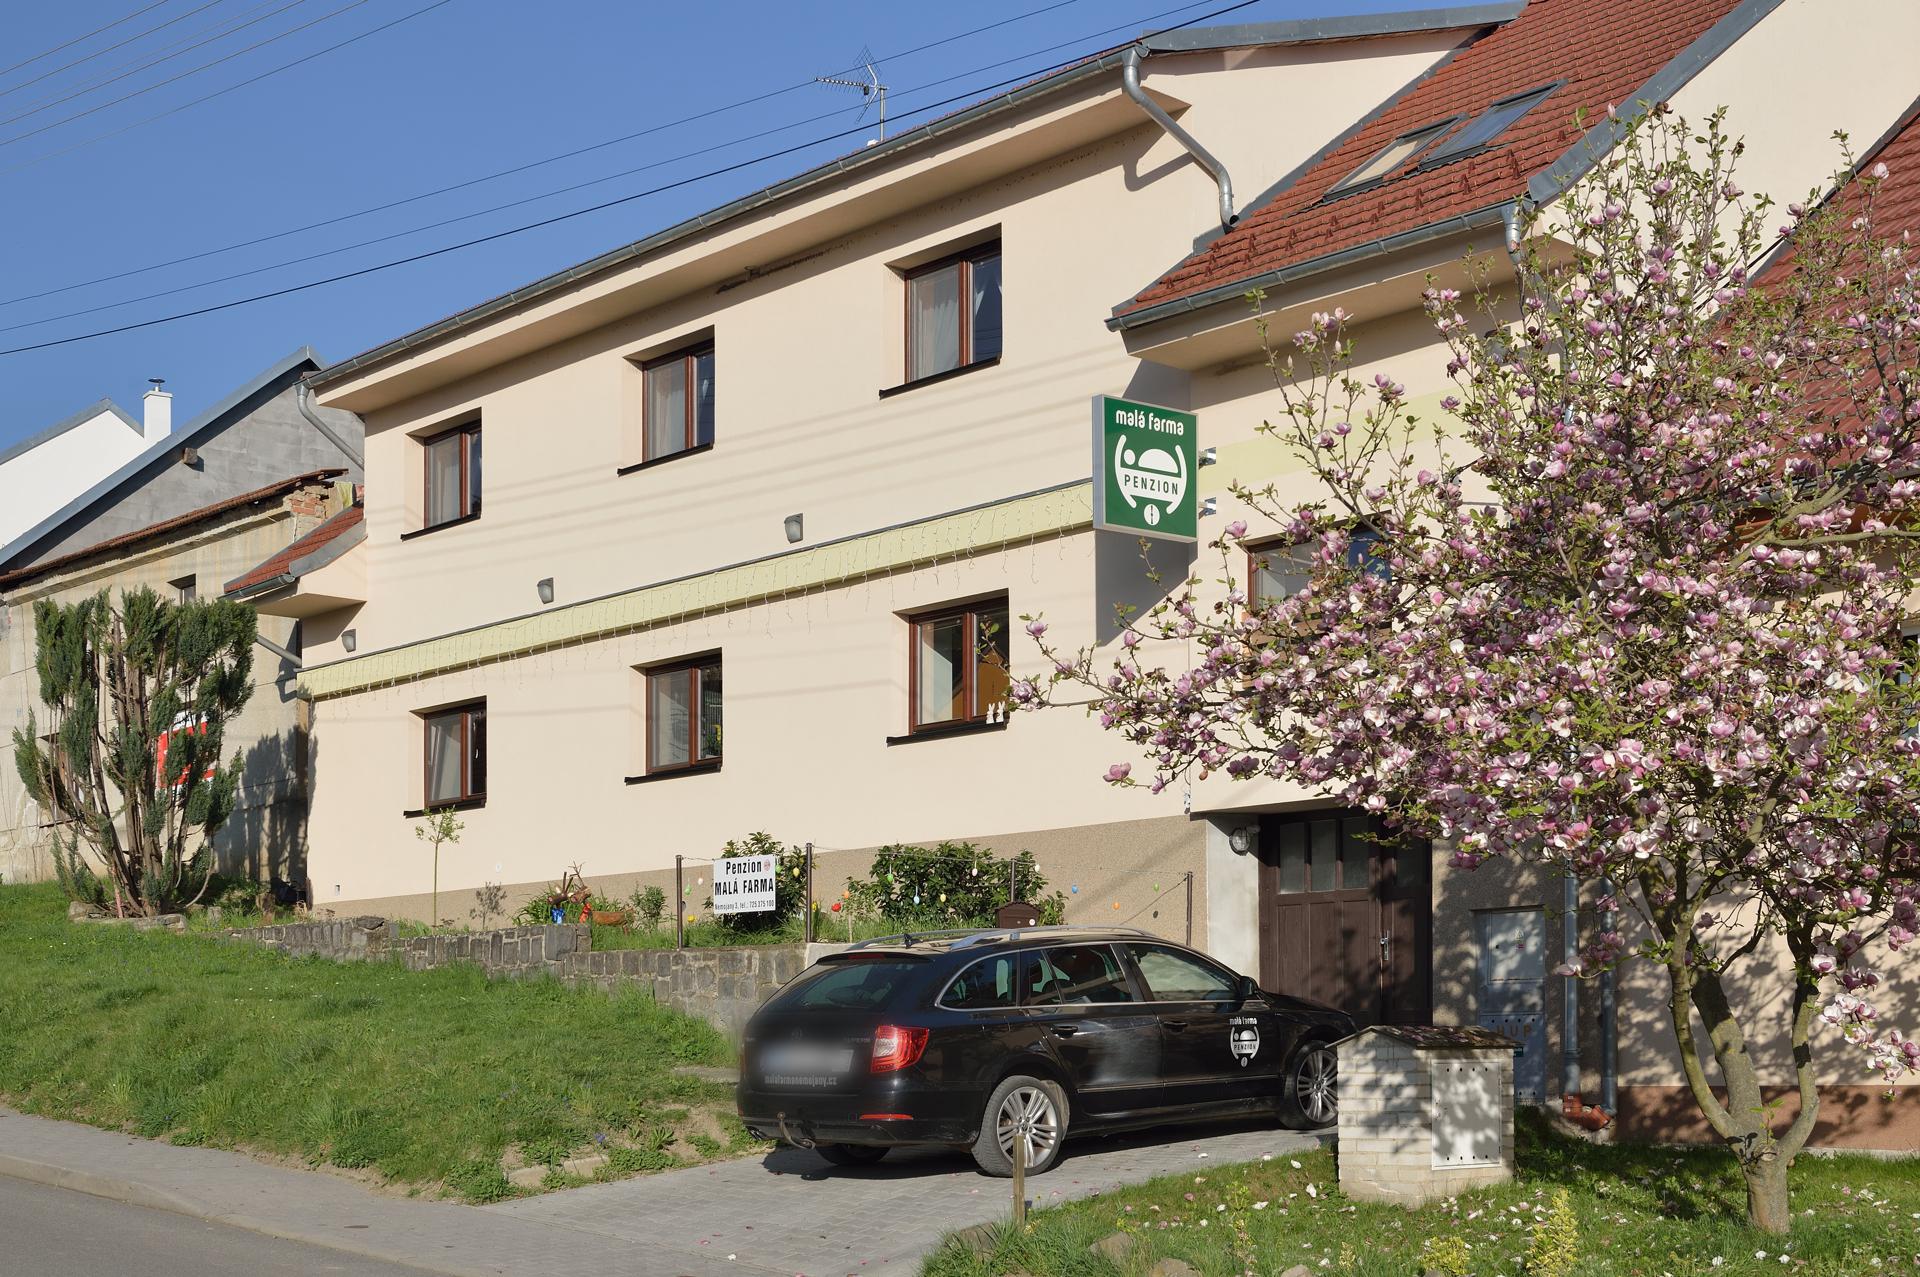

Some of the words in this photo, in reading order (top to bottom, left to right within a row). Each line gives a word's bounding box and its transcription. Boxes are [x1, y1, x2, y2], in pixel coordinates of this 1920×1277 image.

[1115, 409, 1145, 429] malá
[1148, 412, 1184, 436] farma
[1124, 474, 1178, 496] PENZION
[726, 859, 762, 875] Penzion
[715, 878, 738, 896] MALÁ
[743, 878, 774, 894] FARMA
